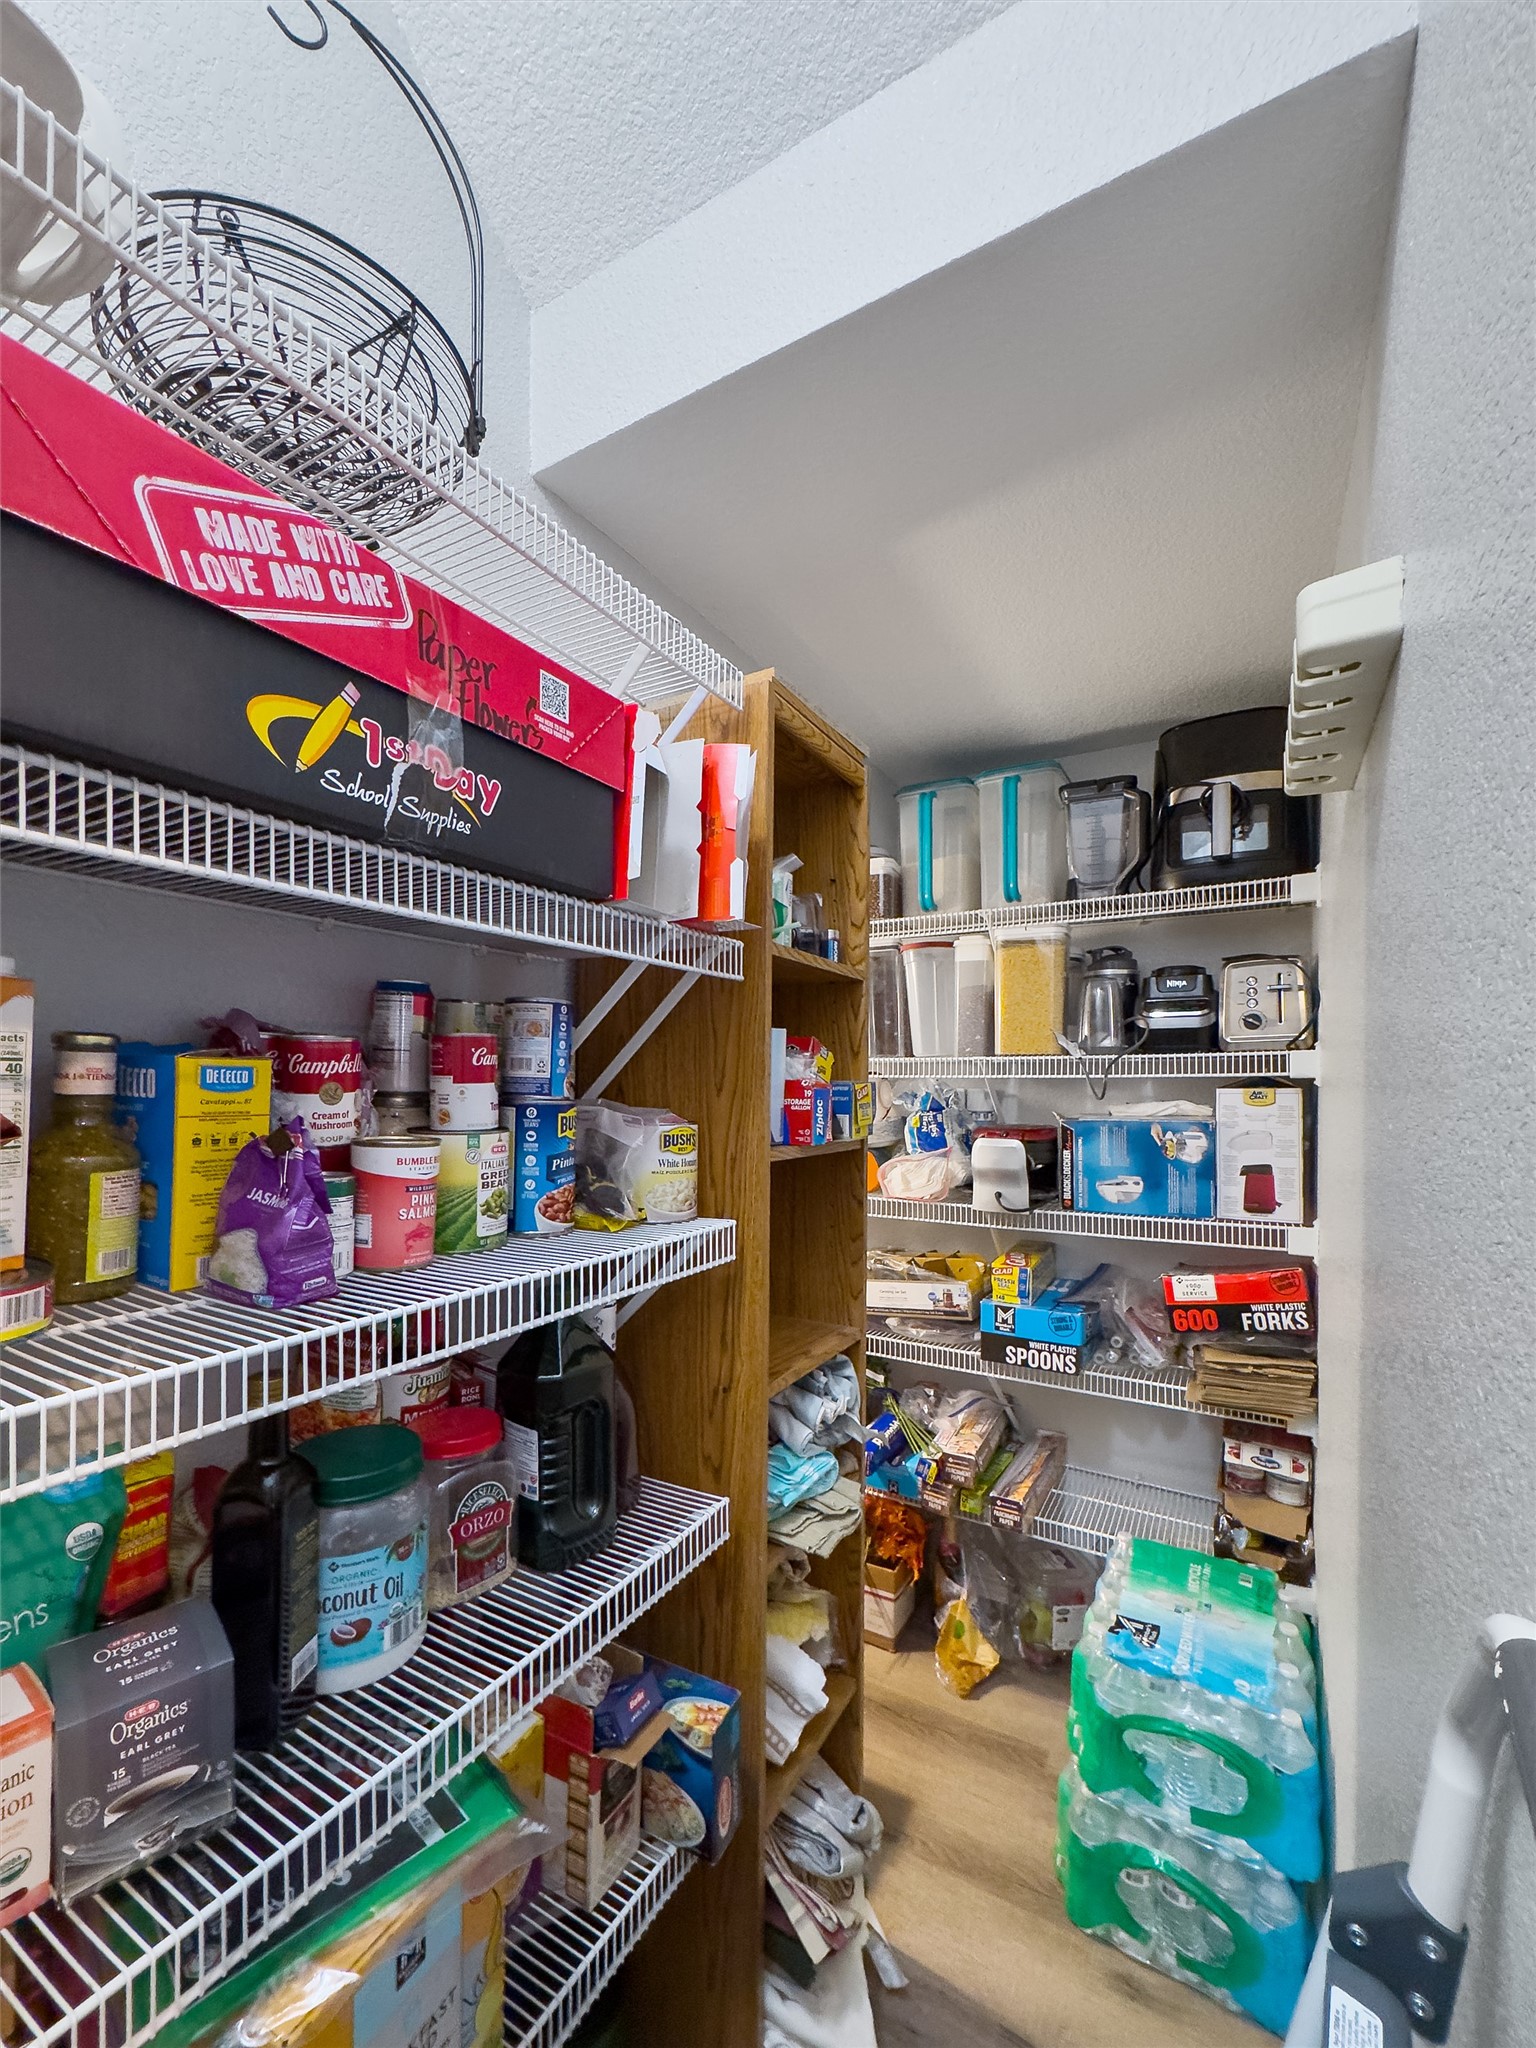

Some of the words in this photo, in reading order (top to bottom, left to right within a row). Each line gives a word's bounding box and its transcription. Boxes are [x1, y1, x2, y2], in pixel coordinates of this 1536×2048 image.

[194, 508, 287, 557] MADE
[289, 523, 360, 567] WITH
[181, 550, 263, 596] LOVE
[269, 562, 325, 602] AND
[329, 569, 393, 608] CARE
[418, 608, 498, 694] Paper
[457, 679, 545, 750] Flowers
[320, 769, 391, 808] School
[398, 796, 472, 837] Supplies
[0, 1034, 24, 1042] acts
[5, 1063, 22, 1074] 40
[803, 1090, 812, 1098] 19
[312, 1111, 340, 1120] Cream
[341, 1110, 349, 1119] of
[816, 1099, 826, 1136] Ziploc
[309, 1120, 353, 1130] Mushroom
[320, 1135, 343, 1143] SOUP
[397, 1156, 433, 1166] BUMBLE
[657, 1158, 680, 1168] White
[481, 1170, 509, 1181] GREE
[482, 1177, 509, 1190] BEAN
[411, 1193, 436, 1207] PINK
[399, 1205, 437, 1220] SALMO
[992, 1267, 1012, 1275] GLAD
[1250, 1303, 1274, 1312] WHITE
[1275, 1302, 1307, 1311] PLASTIC
[1173, 1308, 1219, 1332] 600
[1241, 1311, 1309, 1332] FORKS
[1028, 1340, 1048, 1351] WHITE
[1049, 1345, 1077, 1355] PLASTIC
[1005, 1345, 1077, 1375] SPOONS
[461, 1385, 480, 1396] RICE
[460, 1507, 505, 1538] ORZO
[993, 1510, 1021, 1523] PARCHMENT
[999, 1518, 1014, 1528] PAPER
[331, 1567, 378, 1585] ORGANIC
[384, 1571, 404, 1600] Oil
[0, 1602, 49, 1643] ens
[93, 1626, 178, 1664] Organics
[105, 1655, 139, 1673] EARL
[143, 1640, 178, 1658] GREY
[119, 1675, 133, 1686] 15
[110, 1700, 188, 1745] Organics
[120, 1741, 151, 1760] EARL
[154, 1724, 186, 1745] GREY
[142, 1750, 163, 1763] BLACK
[0, 1764, 35, 1794] anic
[112, 1767, 126, 1781] 15
[0, 1791, 33, 1822] ion
